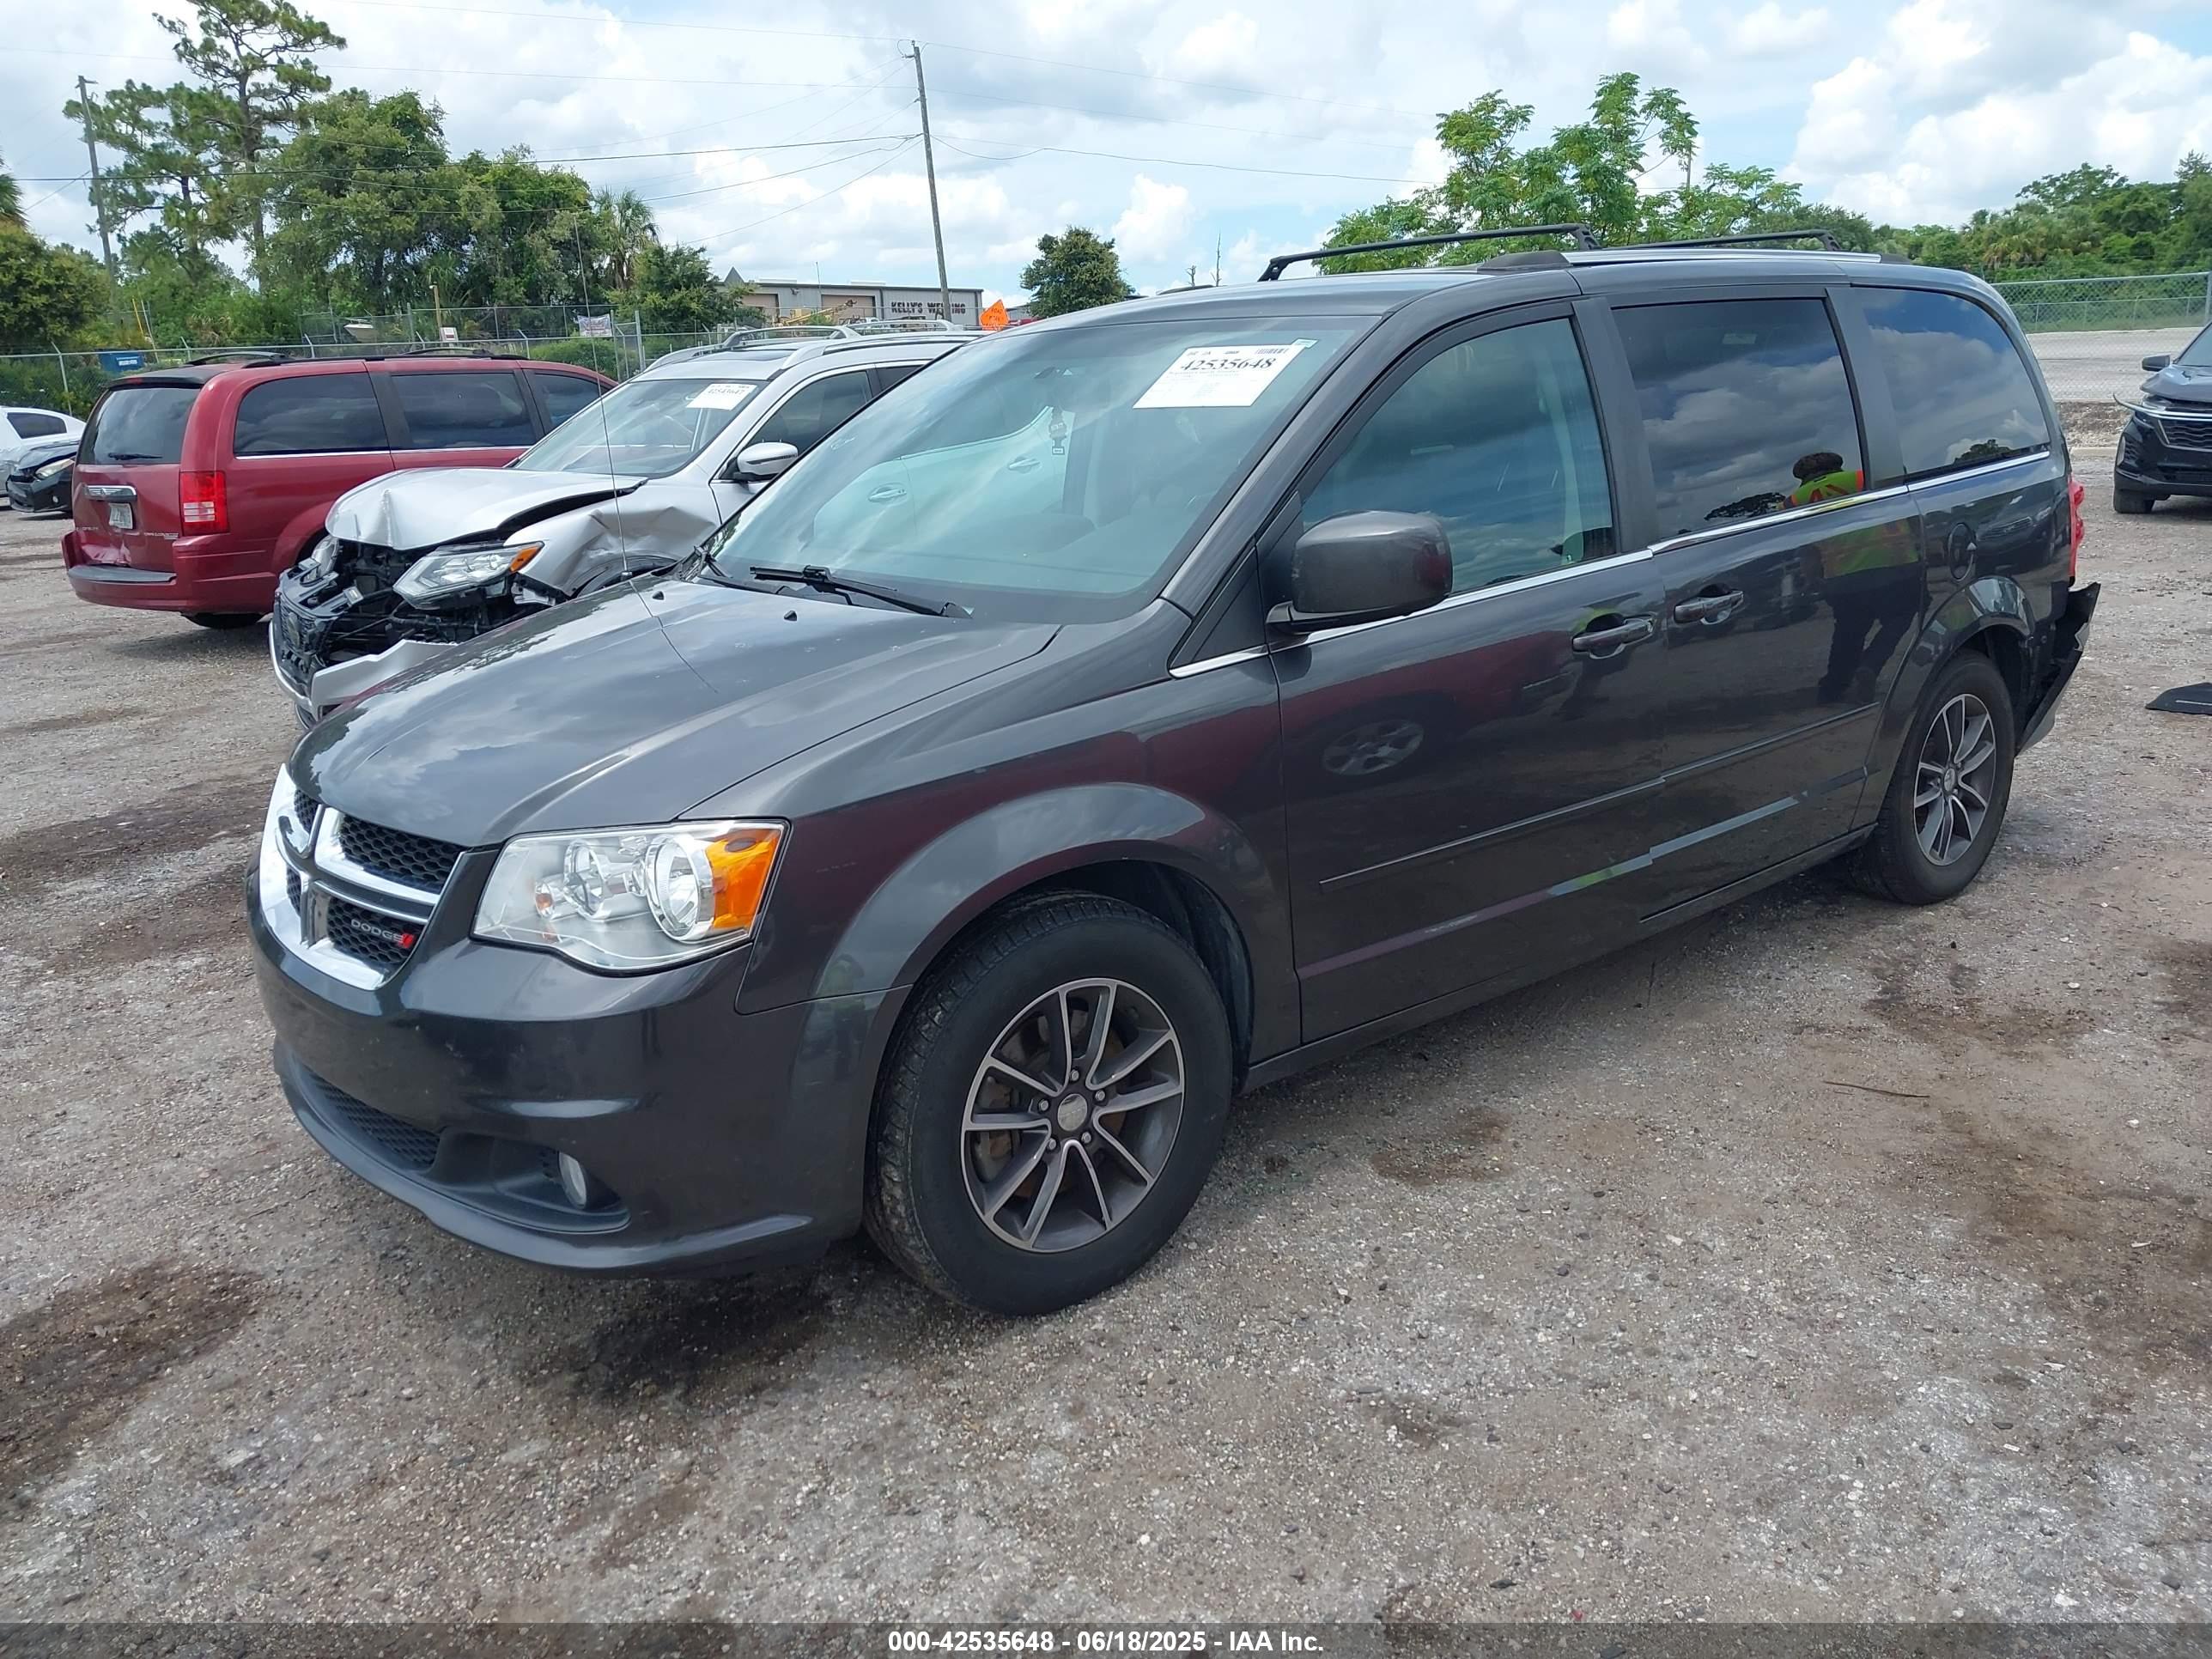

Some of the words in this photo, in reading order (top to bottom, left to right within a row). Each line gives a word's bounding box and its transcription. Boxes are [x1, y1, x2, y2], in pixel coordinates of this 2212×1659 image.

[890, 301, 923, 313] KELLY'S
[927, 302, 966, 314] WELING
[1182, 357, 1276, 370] 42535648
[350, 919, 404, 944] DODGE
